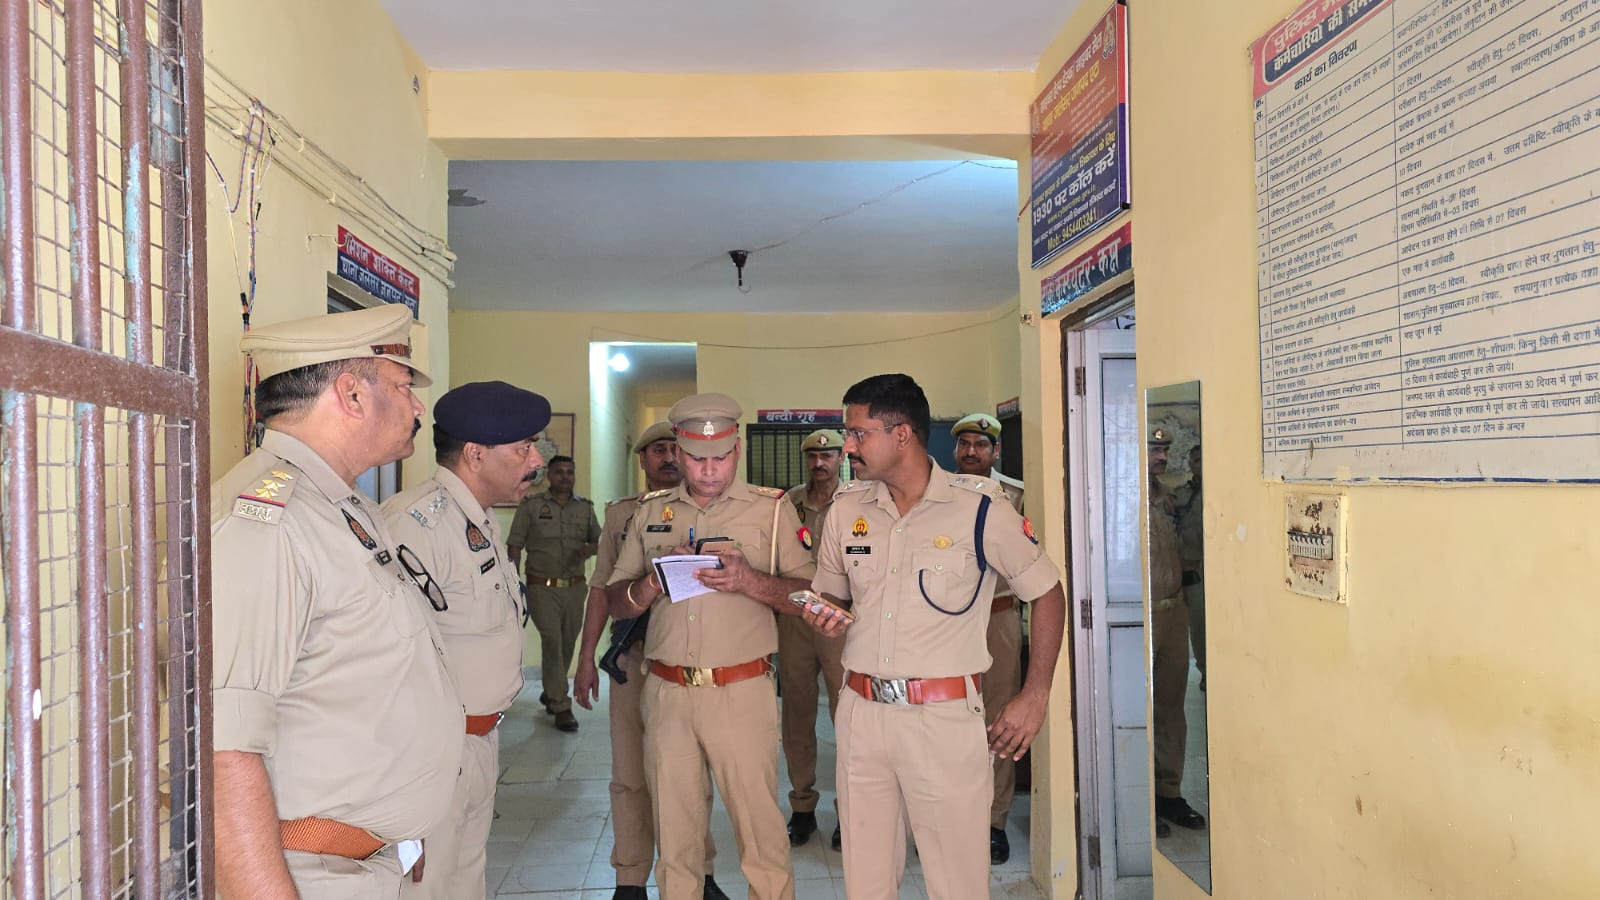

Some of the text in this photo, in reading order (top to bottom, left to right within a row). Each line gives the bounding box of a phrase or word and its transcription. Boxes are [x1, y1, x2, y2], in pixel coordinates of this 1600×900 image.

[1488, 3, 1497, 15] की
[1560, 1, 1588, 22] अनुदान
[1328, 8, 1342, 31] की
[1578, 26, 1586, 38] के
[1294, 40, 1357, 90] कार्य का विवरण
[1468, 157, 1485, 170] दिवस
[1584, 110, 1592, 121] के
[1033, 198, 1052, 221] 1930
[1054, 188, 1068, 206] पर
[1069, 169, 1094, 196] कॉल
[1095, 142, 1116, 176] करें
[1496, 213, 1504, 224] 07
[1507, 205, 1526, 224] दिवस
[1525, 255, 1537, 267] होने
[1540, 253, 1550, 263] पर
[1555, 272, 1578, 285] प्रत्येक
[1540, 333, 1558, 347] किसी
[1562, 331, 1570, 343] भी
[1474, 367, 1484, 375] कर
[1485, 362, 1494, 373] ली
[1437, 387, 1445, 397] की
[1488, 382, 1495, 392] के
[1525, 380, 1534, 389] 30
[1536, 376, 1557, 387] दिवस
[1569, 371, 1582, 387] पूर्ण
[1584, 373, 1598, 382] कर
[766, 409, 793, 422] बन्दी
[1453, 408, 1463, 417] एक
[1494, 400, 1504, 414] पूर्ण
[1520, 398, 1528, 410] ली
[1552, 397, 1580, 408] सत्यापन
[1473, 425, 1481, 433] 07
[1483, 422, 1495, 432] दिन
[1498, 421, 1504, 431] के
[1507, 422, 1525, 431] अन्दर
